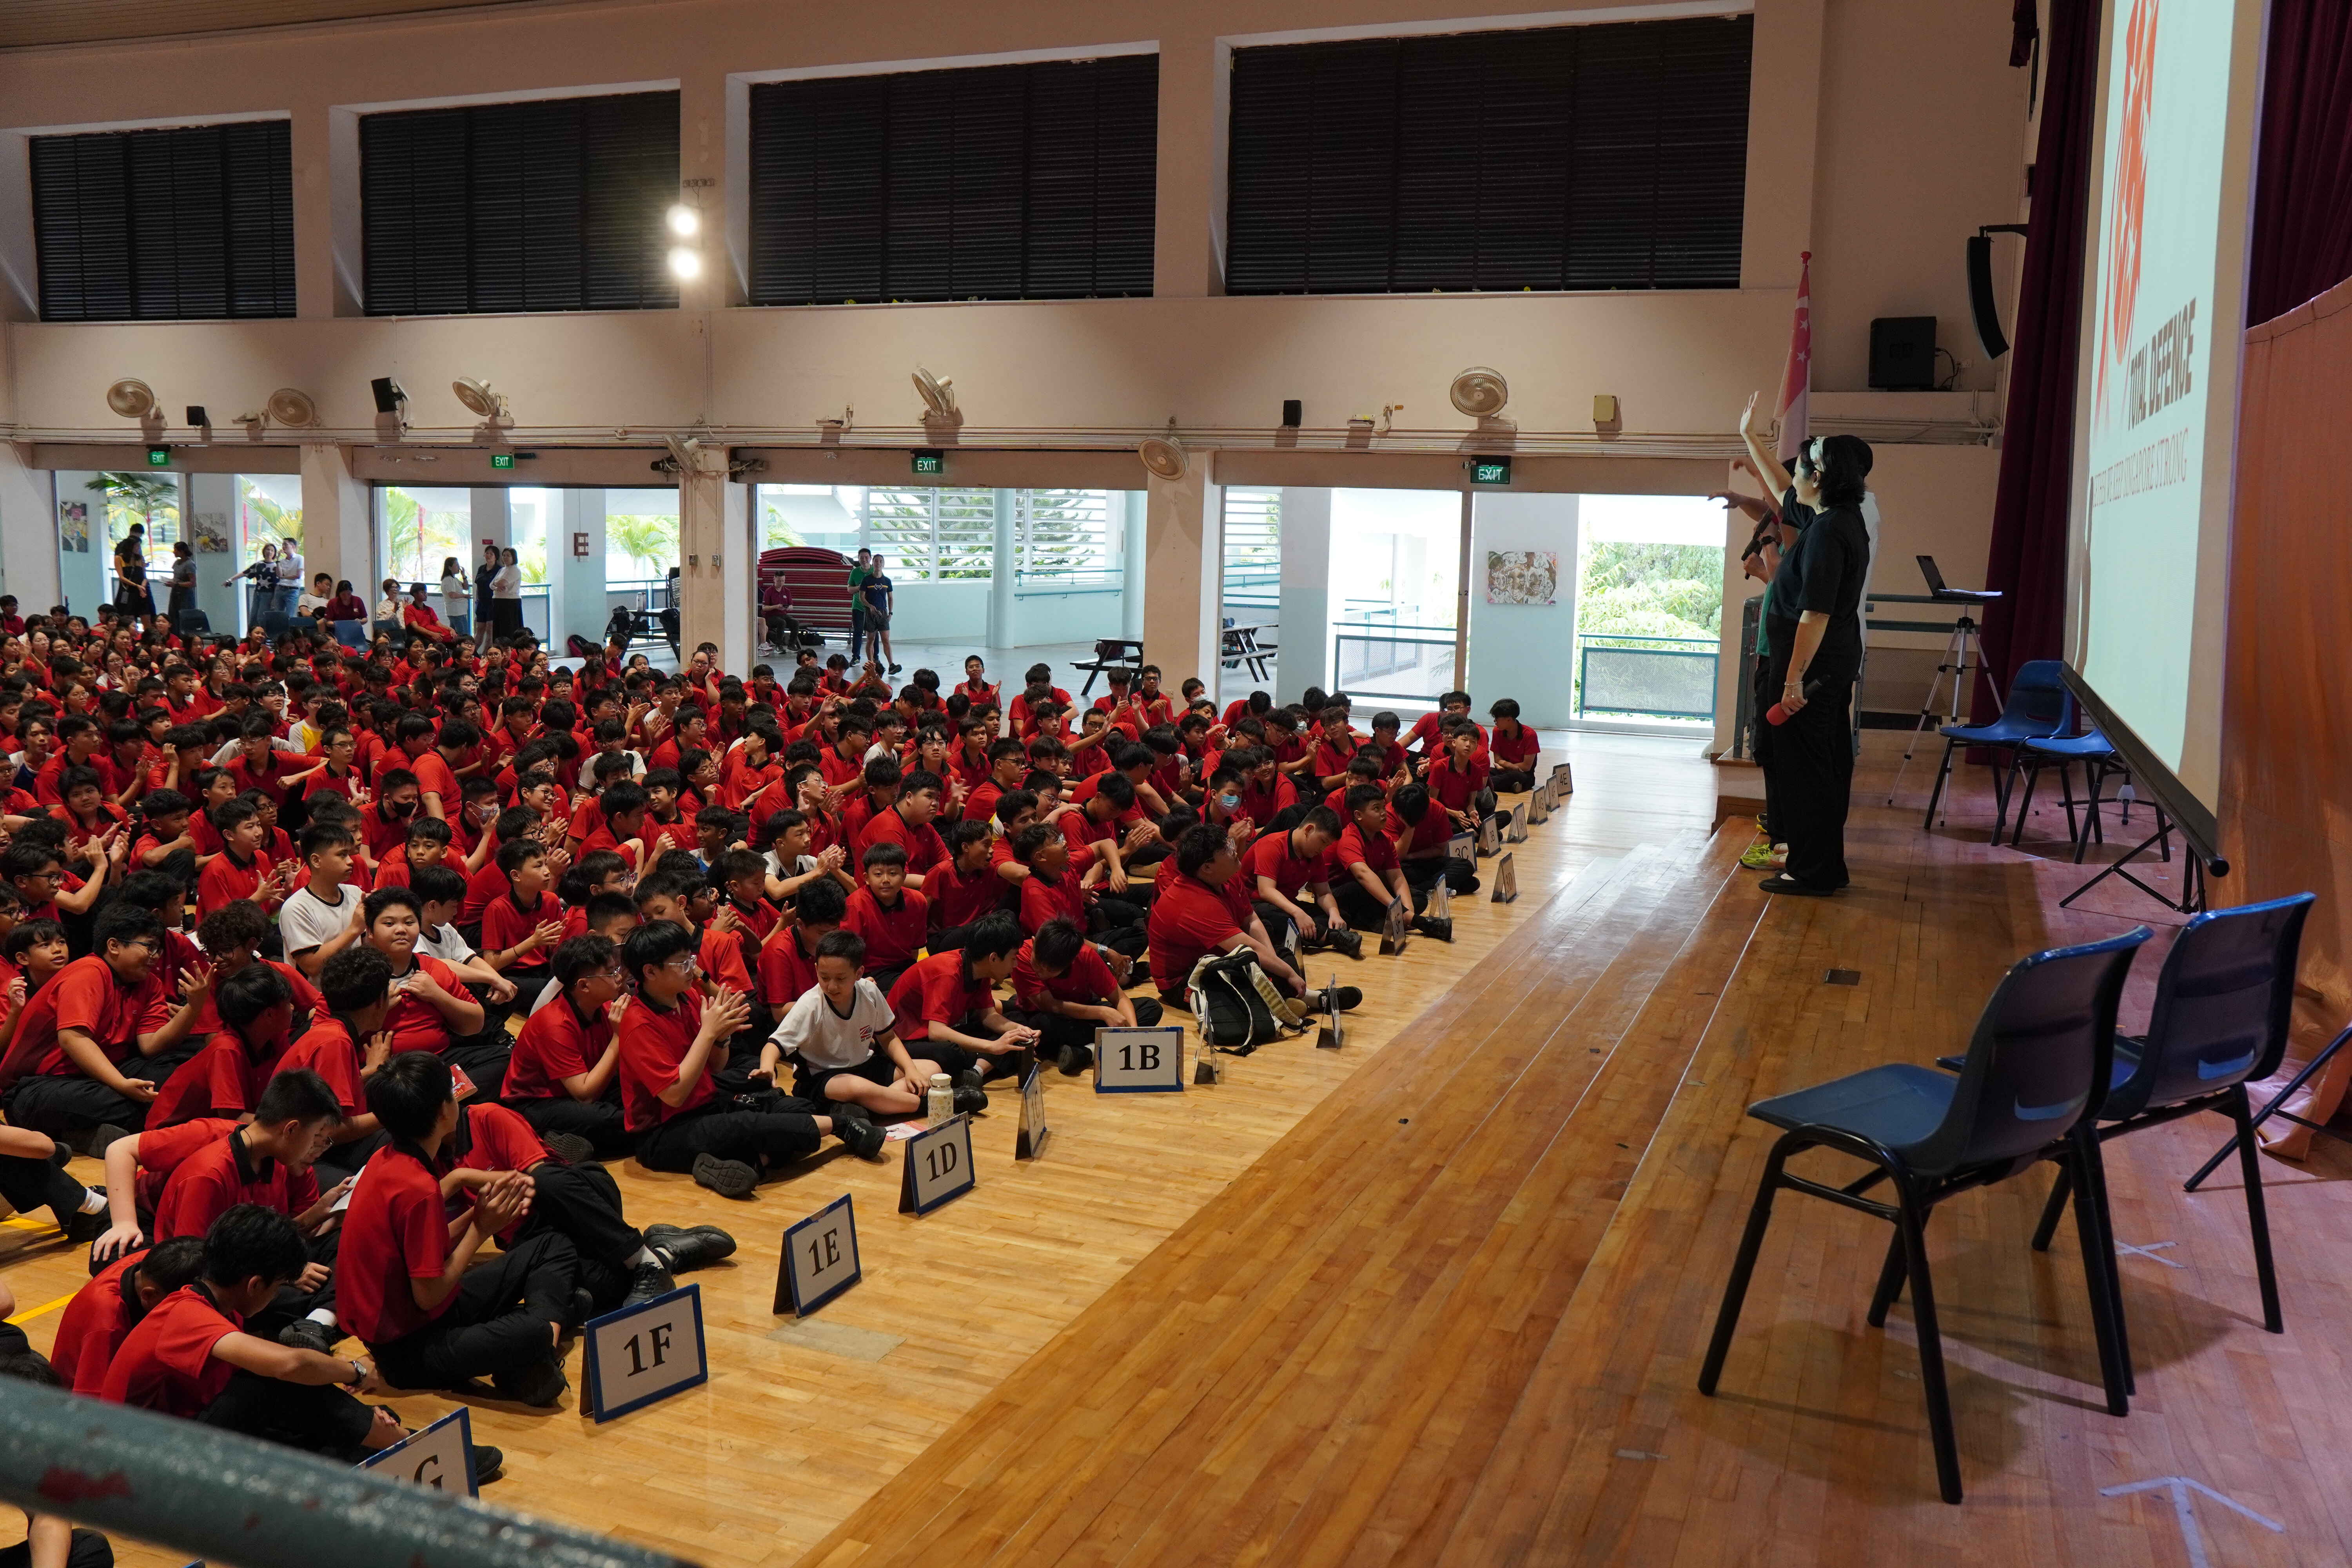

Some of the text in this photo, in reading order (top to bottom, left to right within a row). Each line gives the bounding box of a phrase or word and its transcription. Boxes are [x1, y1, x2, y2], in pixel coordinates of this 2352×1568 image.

[2129, 297, 2196, 431] TOTAL DEFENCE
[152, 454, 165, 463] EXIT
[495, 457, 509, 466] EXIT
[918, 460, 936, 471] EXIT
[2123, 444, 2155, 498] SINGAPORE
[2156, 427, 2188, 489] STRONG
[1478, 469, 1502, 480] EXIT
[1560, 773, 1568, 786] 4E
[1538, 797, 1544, 810] 4G
[1490, 830, 1495, 842] 3B
[1455, 846, 1469, 860] 3C
[1395, 913, 1401, 935] 3F
[1119, 1045, 1160, 1070] 1B
[926, 1142, 956, 1182] 1D
[809, 1227, 840, 1277] 1E
[624, 1322, 672, 1377] 1F
